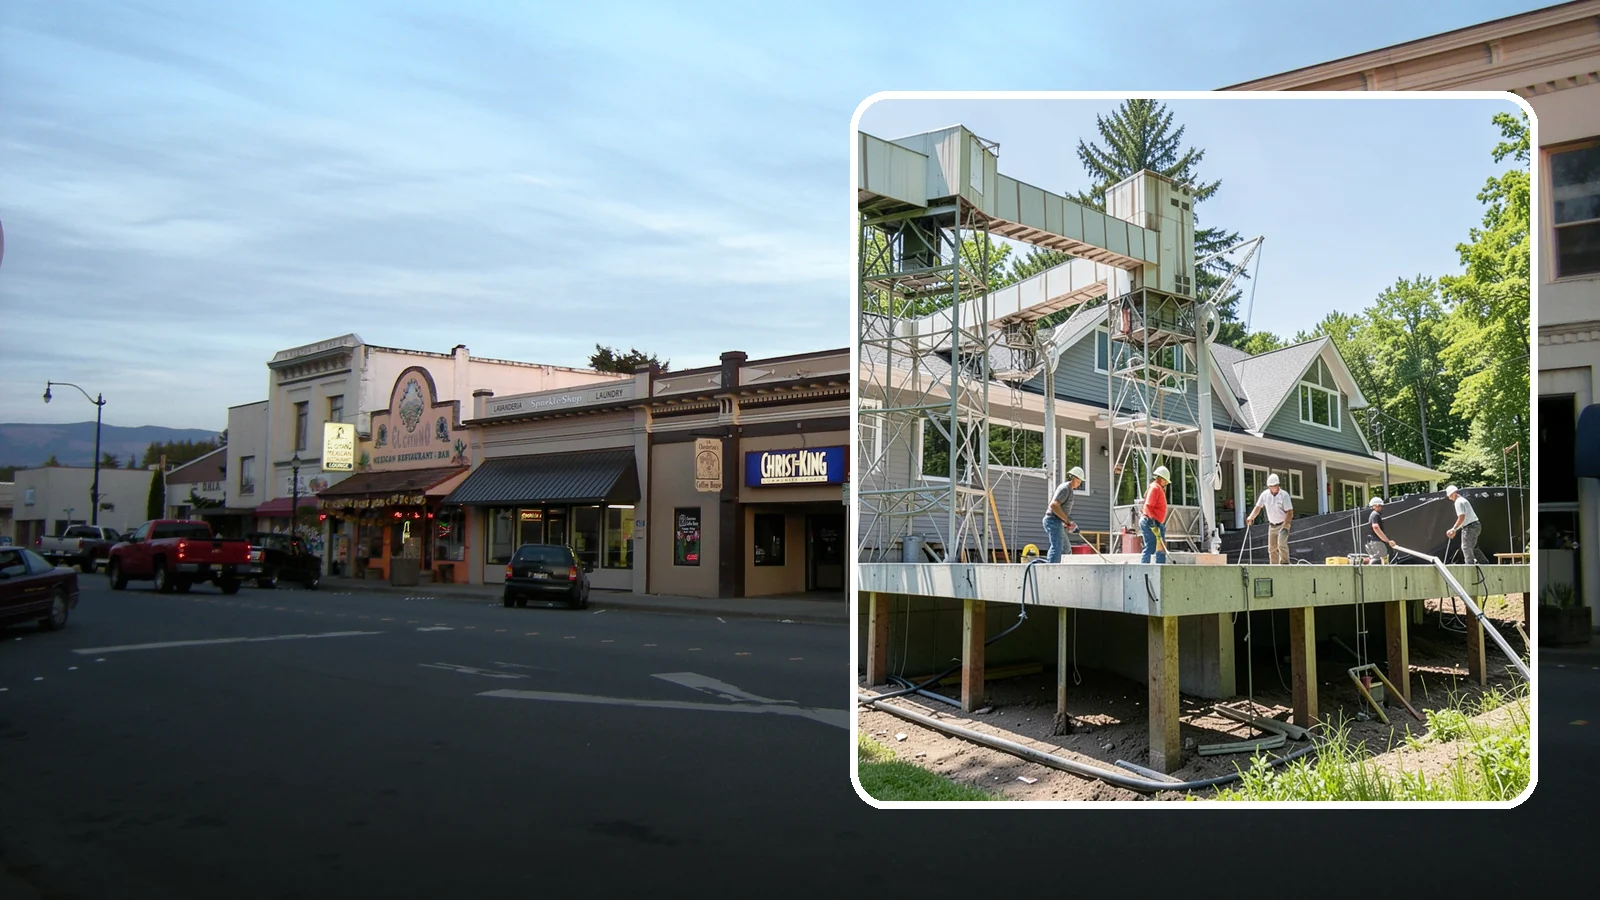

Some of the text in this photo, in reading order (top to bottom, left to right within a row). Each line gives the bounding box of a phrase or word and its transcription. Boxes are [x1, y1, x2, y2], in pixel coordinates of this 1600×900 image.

[595, 389, 623, 400] LAUNDRY
[493, 402, 522, 412] LAVANDERIA
[530, 394, 583, 409] Sparkle Shop
[374, 450, 450, 464] MEXICAN RESTAURANT BAR
[697, 480, 709, 489] Coffee
